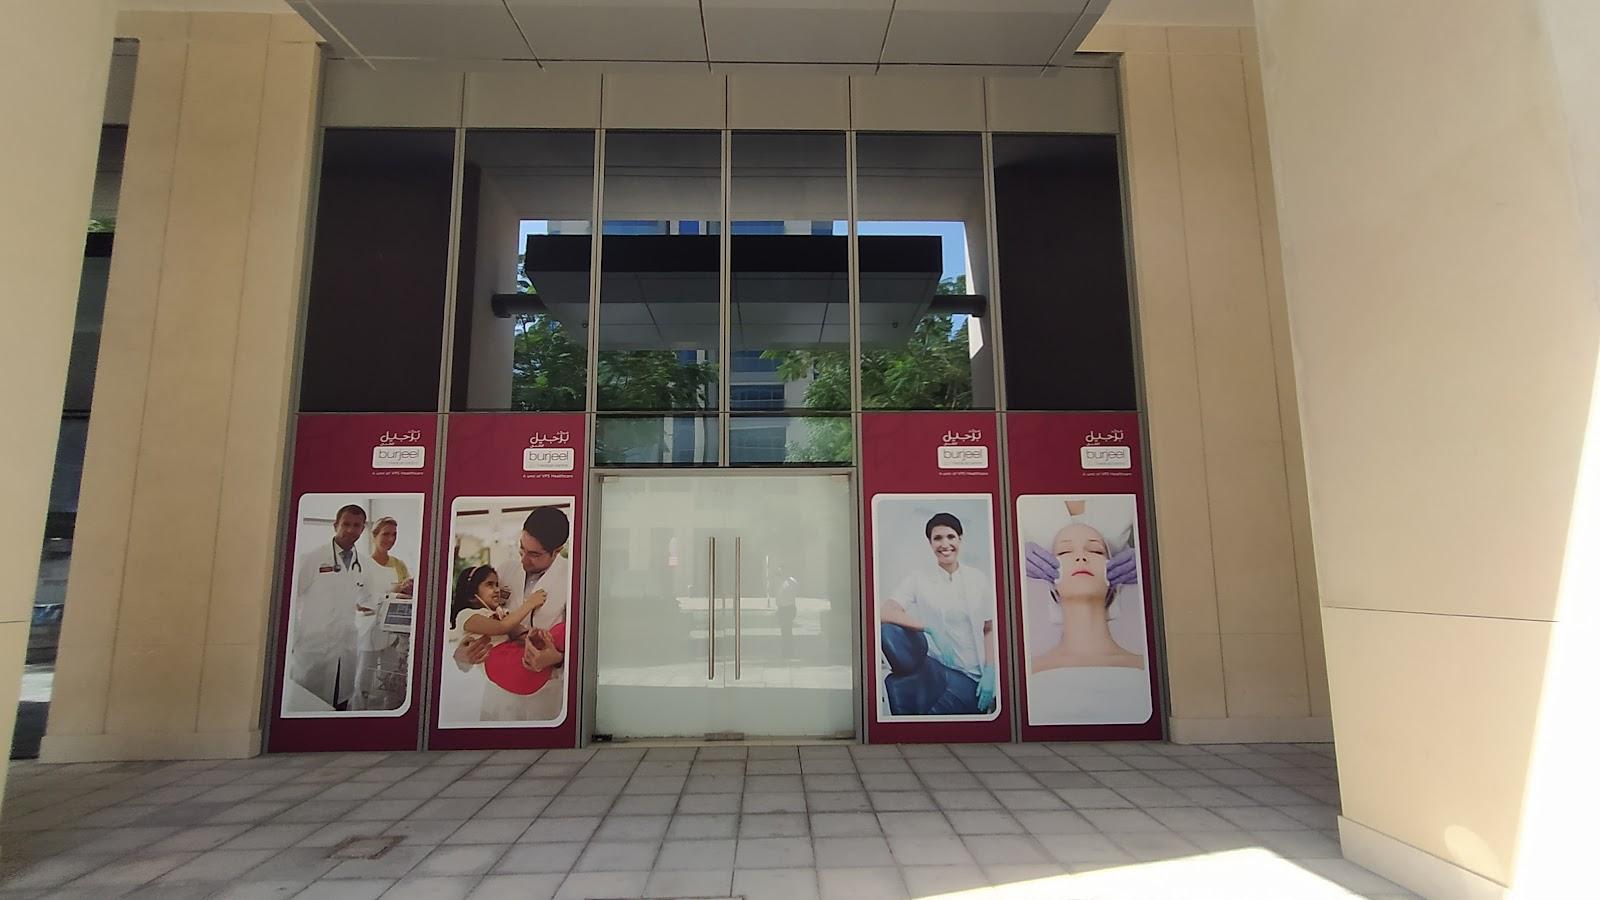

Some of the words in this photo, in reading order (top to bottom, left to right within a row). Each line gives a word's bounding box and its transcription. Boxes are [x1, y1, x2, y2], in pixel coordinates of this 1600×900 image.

[379, 449, 419, 461] burjeel
[529, 451, 569, 463] burjeel
[943, 449, 983, 461] burjeel
[1086, 450, 1124, 461] burjeel
